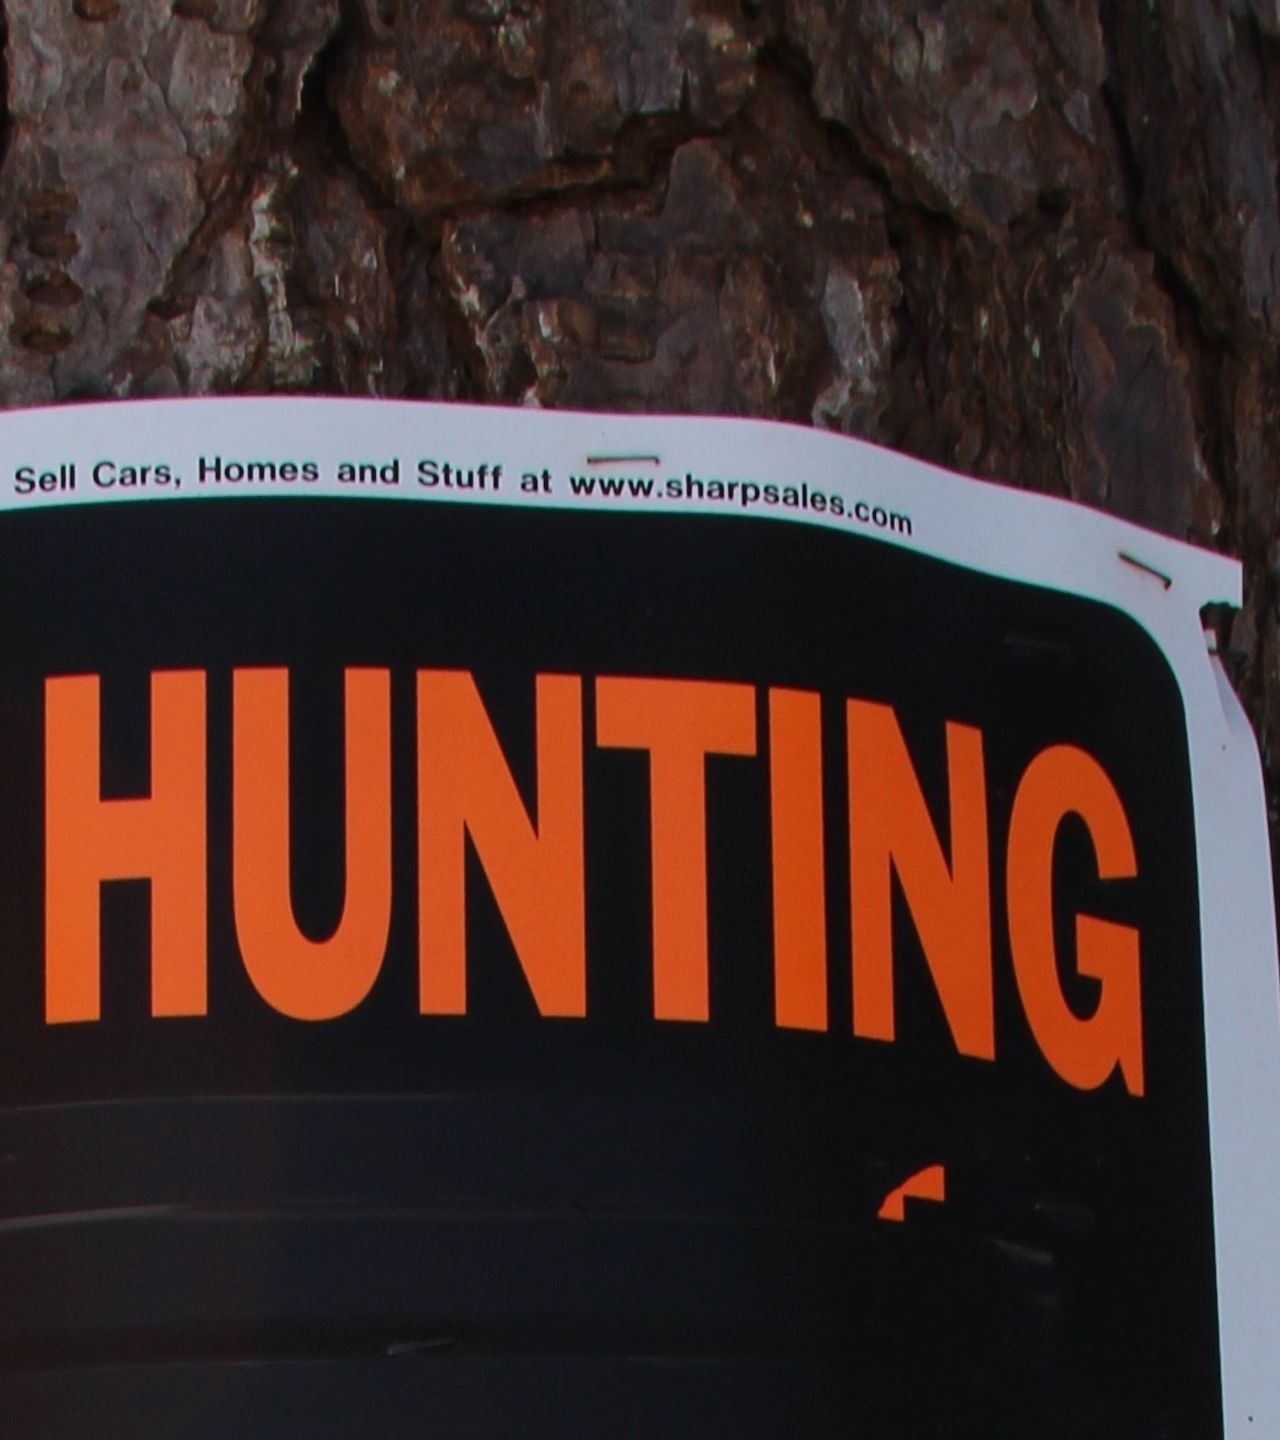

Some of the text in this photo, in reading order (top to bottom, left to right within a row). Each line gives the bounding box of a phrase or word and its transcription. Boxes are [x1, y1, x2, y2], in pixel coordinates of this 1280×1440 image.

[14, 464, 75, 493] Sell
[92, 461, 182, 488] Cars,
[199, 457, 319, 483] Homes
[337, 459, 398, 484] and
[418, 460, 503, 490] Stuff
[521, 469, 552, 493] at
[570, 473, 912, 536] www.sharpsales.com
[43, 666, 1145, 1098] HUNTING
